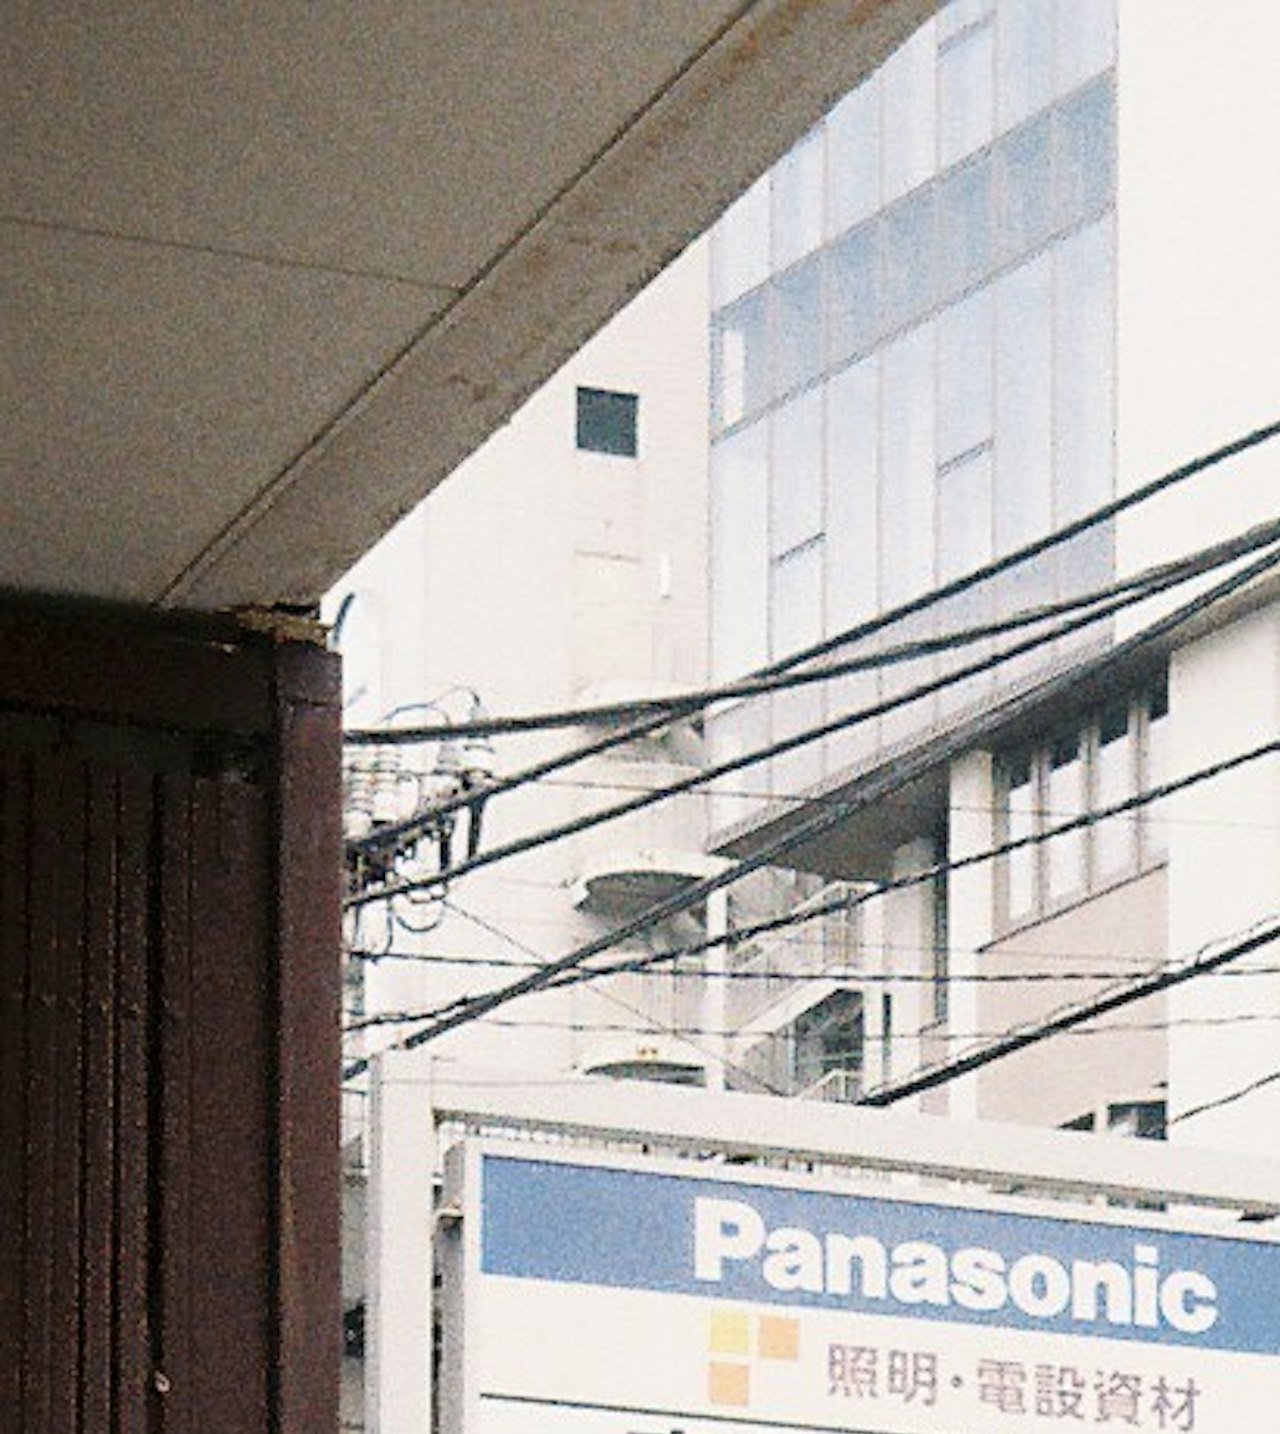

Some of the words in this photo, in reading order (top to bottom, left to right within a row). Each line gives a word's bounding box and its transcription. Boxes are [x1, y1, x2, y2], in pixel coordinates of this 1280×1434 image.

[693, 1197, 1219, 1333] Panasonic
[827, 1343, 1201, 1431] 照明・電設資材
